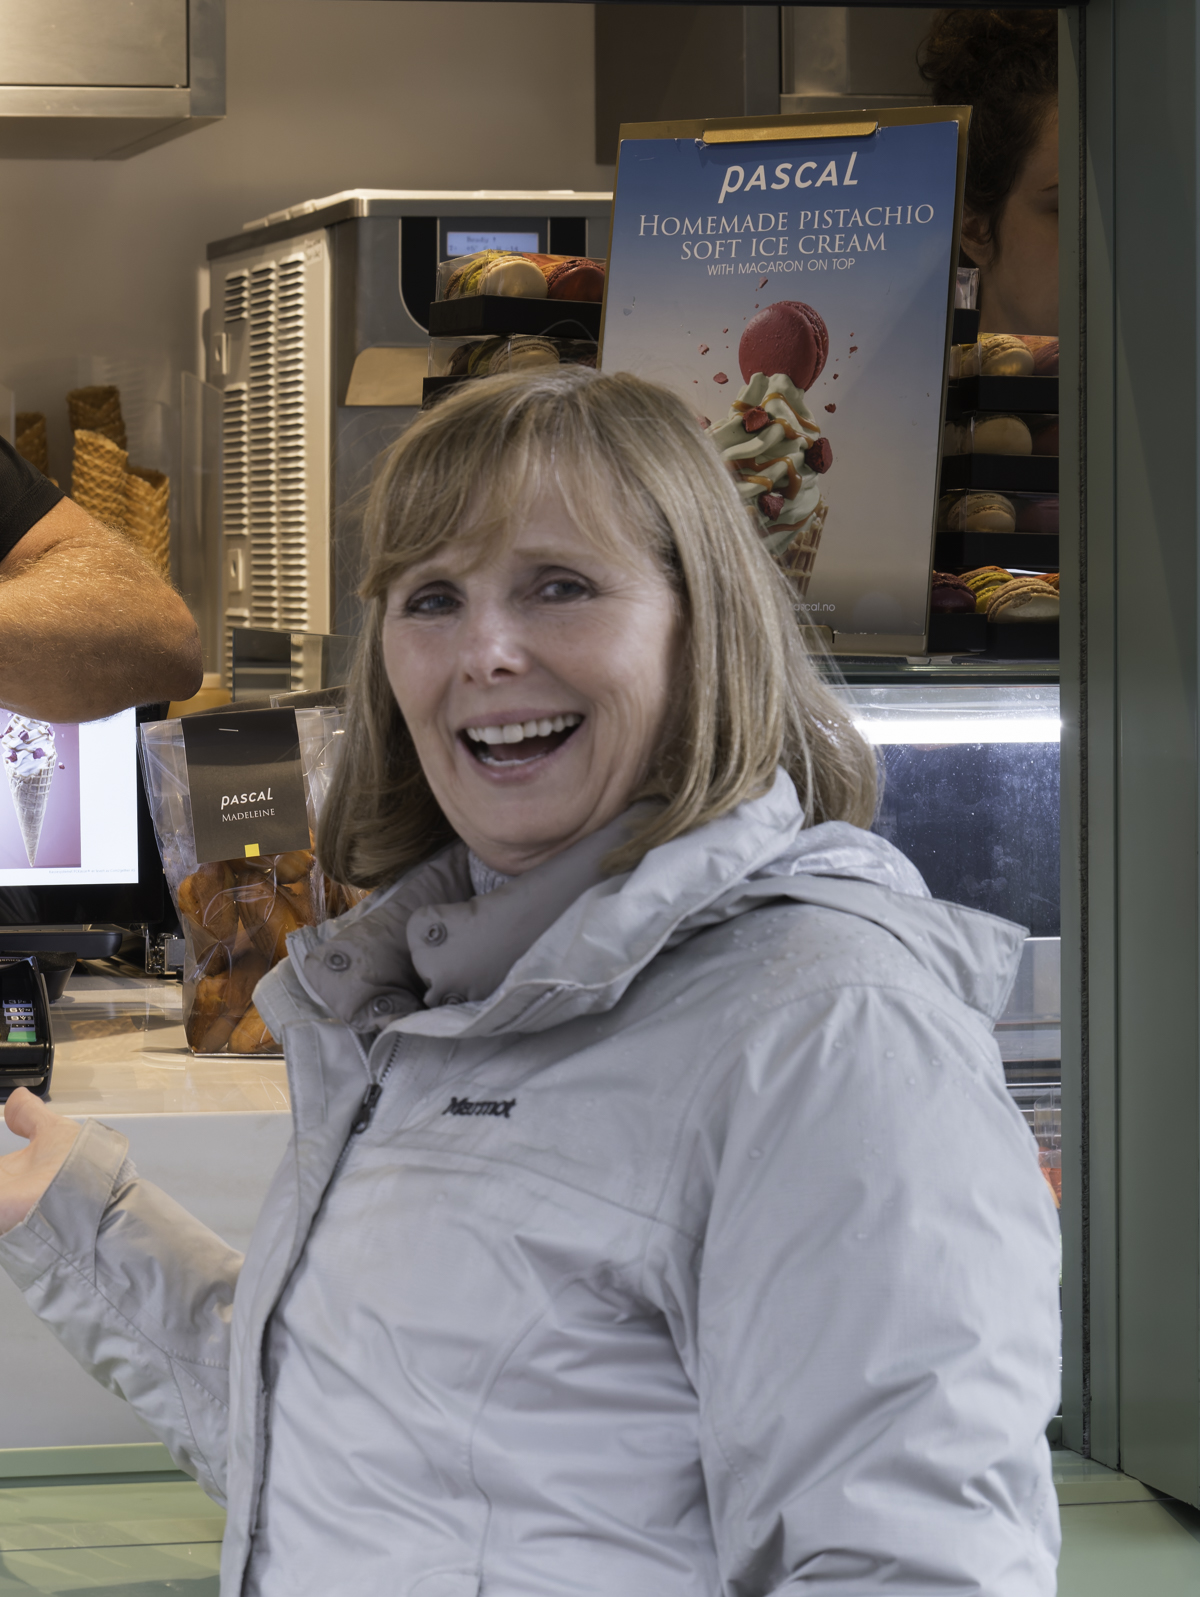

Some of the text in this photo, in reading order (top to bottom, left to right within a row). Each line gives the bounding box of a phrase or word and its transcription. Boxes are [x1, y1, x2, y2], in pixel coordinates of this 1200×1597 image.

[638, 204, 935, 237] HOMEMADE PISTACHIO
[680, 232, 887, 261] SOFT ICE CREAM
[707, 257, 856, 276] WITH MACARON ON TOP
[222, 808, 276, 822] MADELEINE
